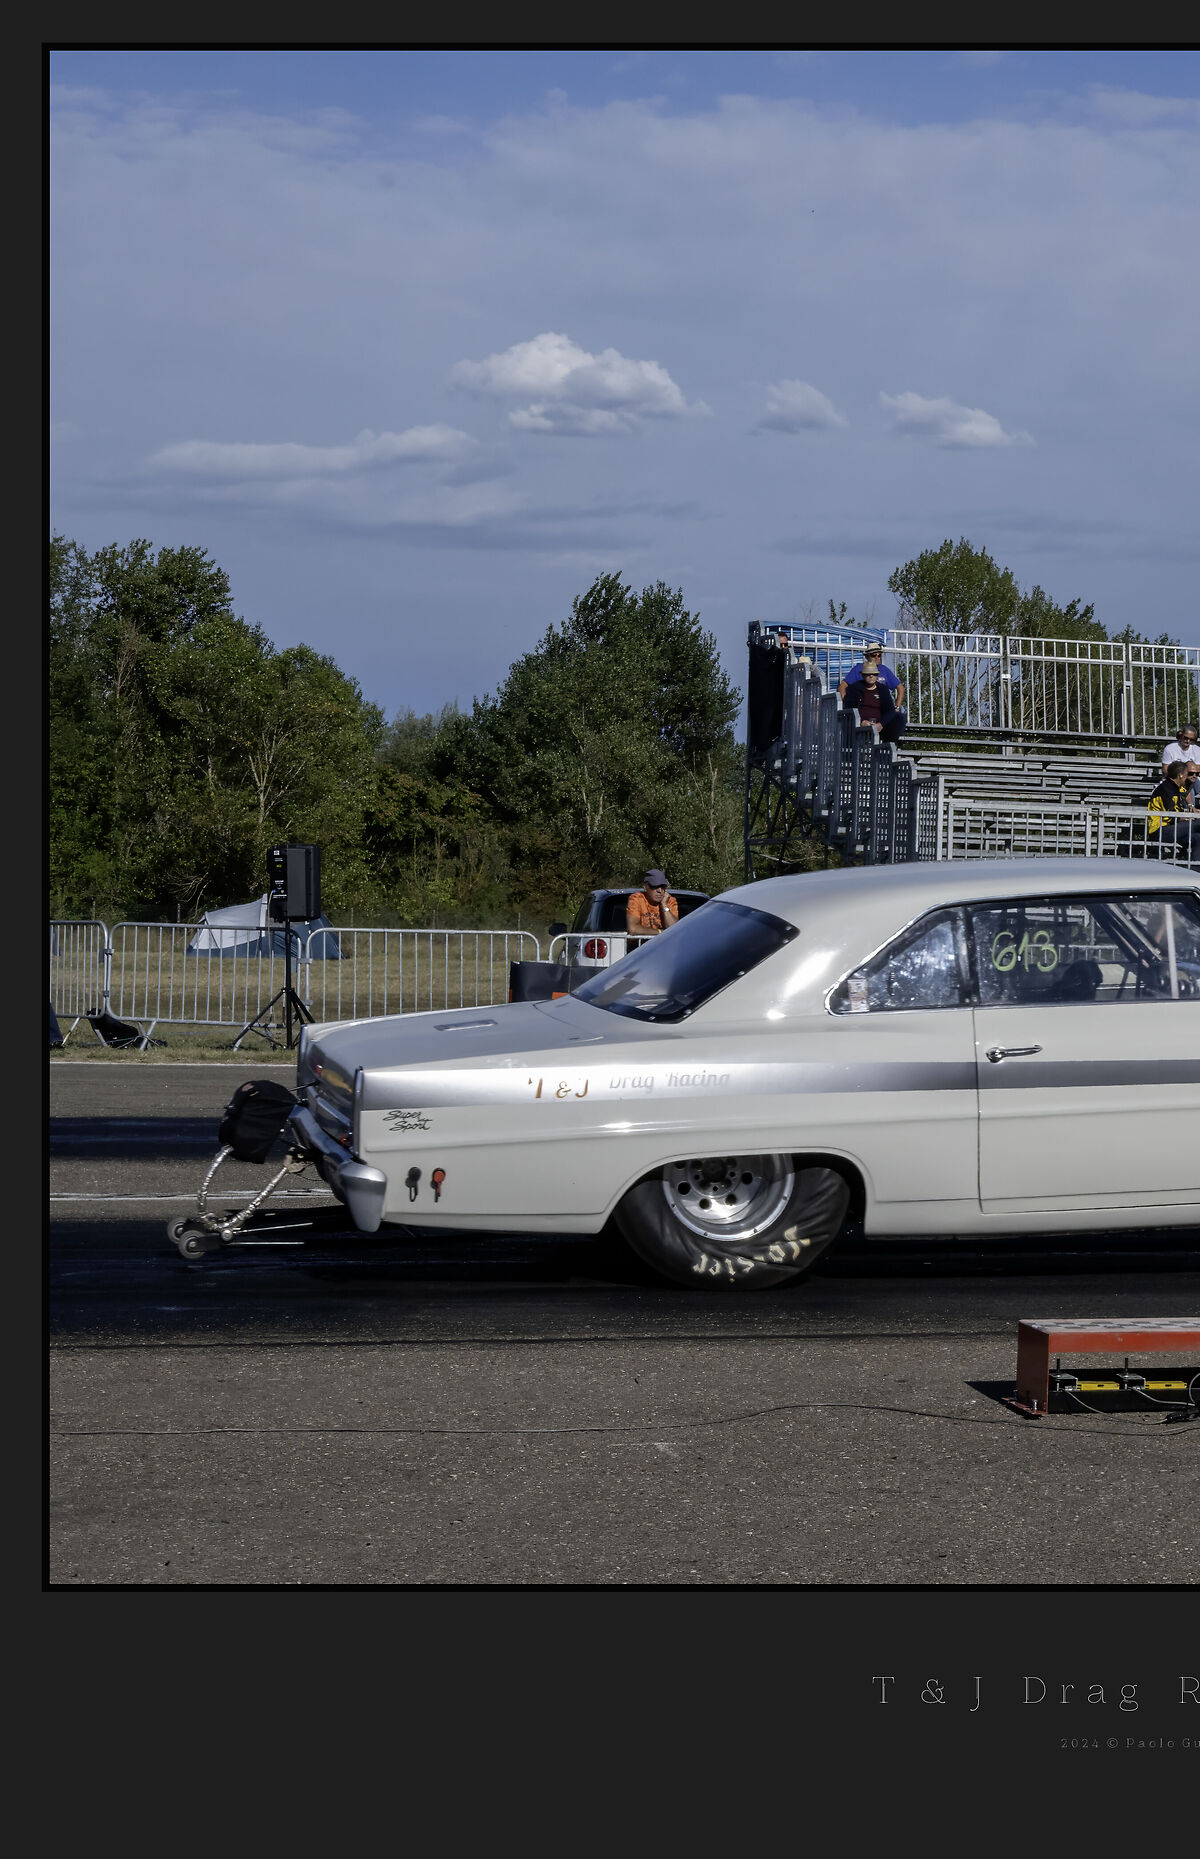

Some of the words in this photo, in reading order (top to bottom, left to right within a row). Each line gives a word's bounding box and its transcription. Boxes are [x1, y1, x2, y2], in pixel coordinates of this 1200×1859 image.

[991, 930, 1058, 973] 613
[382, 1109, 422, 1122] Super
[388, 1117, 433, 1133] Sport
